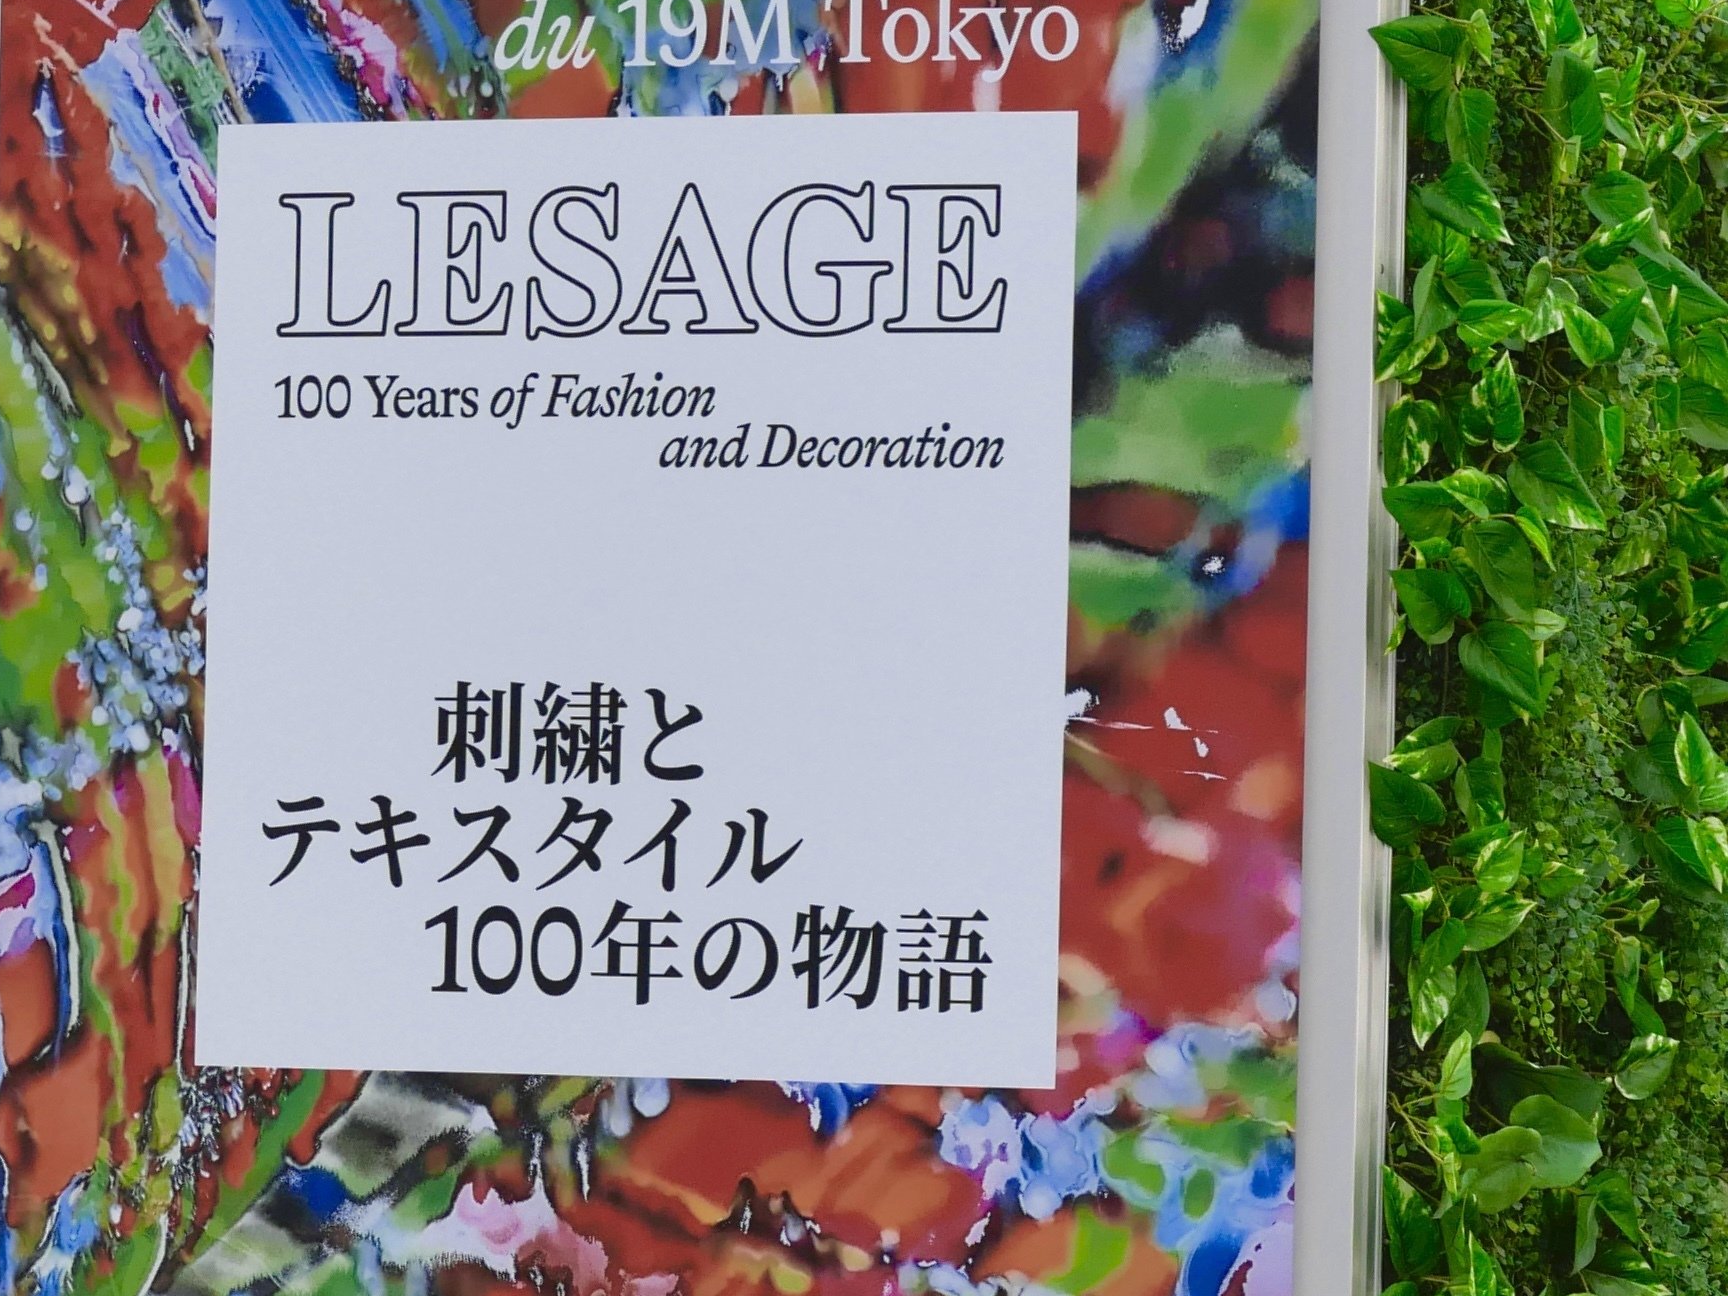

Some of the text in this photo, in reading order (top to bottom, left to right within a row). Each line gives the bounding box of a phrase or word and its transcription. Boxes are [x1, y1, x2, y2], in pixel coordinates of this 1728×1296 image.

[276, 180, 1008, 341] LESAGE
[275, 372, 716, 430] 100 Years of Fashion
[659, 422, 1004, 469] and Decoration
[431, 680, 704, 786] 刺繍と
[262, 795, 803, 892] テキスタイル
[425, 899, 993, 1013] 100年の物語
